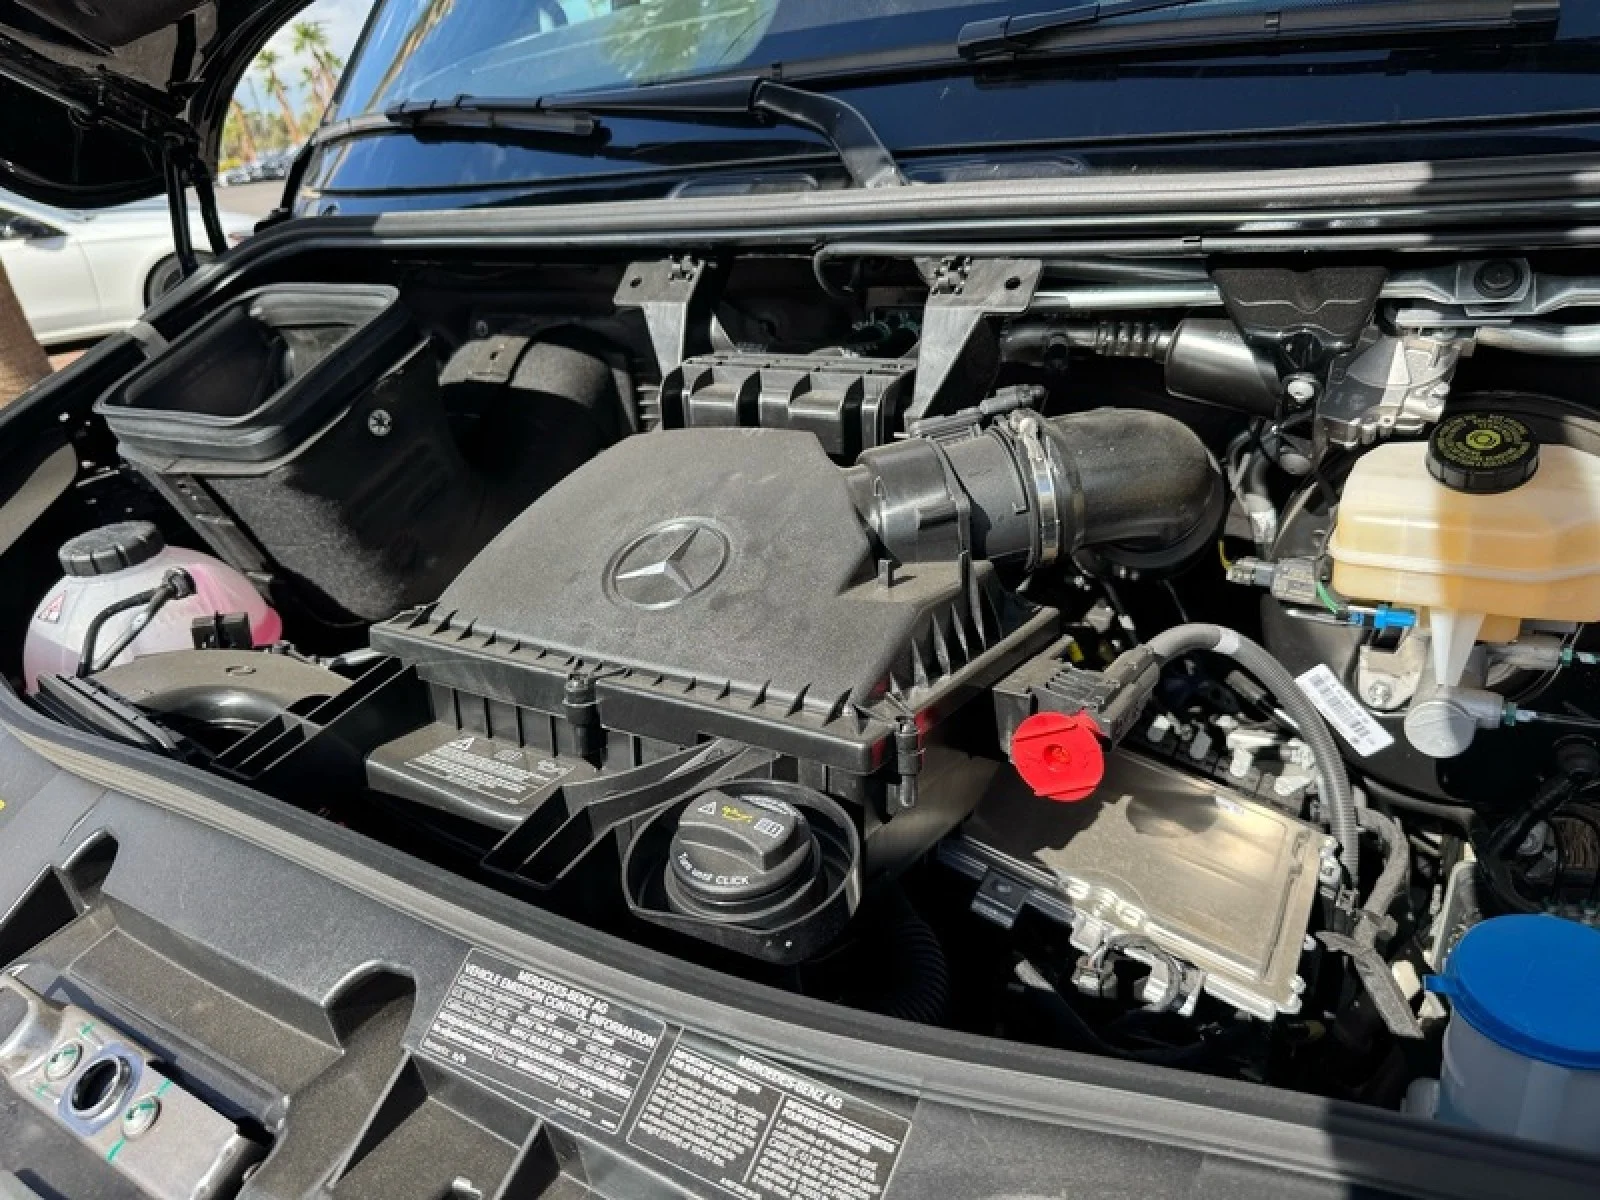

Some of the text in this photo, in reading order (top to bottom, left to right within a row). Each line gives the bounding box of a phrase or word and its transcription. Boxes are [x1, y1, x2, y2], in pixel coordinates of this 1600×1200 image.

[716, 875, 749, 885] CLICK
[465, 963, 657, 1047] VEHICLE EMISSION CONTROL INFORMATION
[518, 970, 609, 1014] MERCEDES-BENZ AG
[737, 1055, 826, 1105] MERCEDES-BENZ
[823, 1094, 843, 1110] AG
